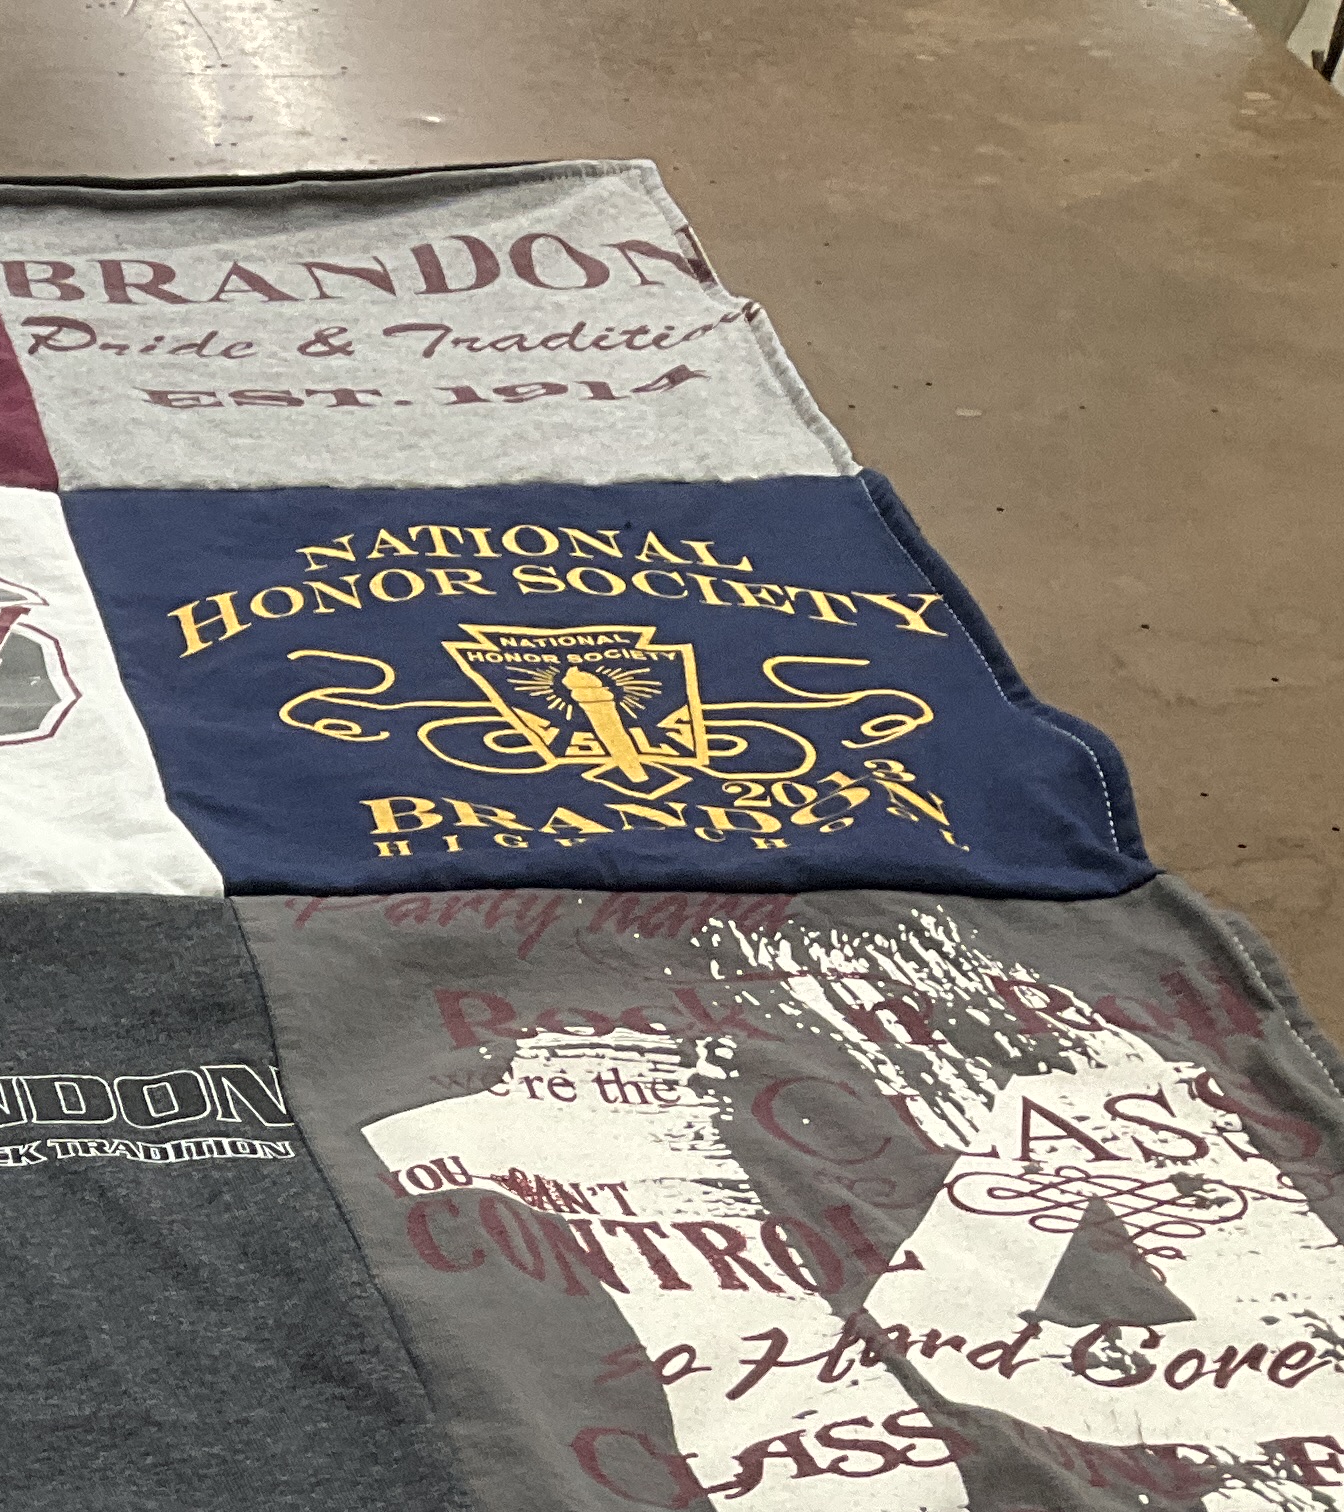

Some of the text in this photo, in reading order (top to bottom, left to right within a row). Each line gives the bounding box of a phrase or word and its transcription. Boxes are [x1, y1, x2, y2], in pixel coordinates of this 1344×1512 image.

[20, 316, 255, 359] Pride
[296, 325, 356, 358] &
[138, 364, 712, 408] EST. 1914
[296, 523, 753, 573] NATIONAL
[167, 563, 950, 659] HONOR SOCIETY
[468, 648, 679, 665] HONOR SOCIETY
[499, 633, 631, 649] NATIONAL
[723, 758, 917, 809] 2013
[362, 779, 950, 835] BRANDON
[590, 1066, 682, 1104] the
[46, 1137, 297, 1164] TRADITION
[406, 1196, 925, 1297] CONTROL
